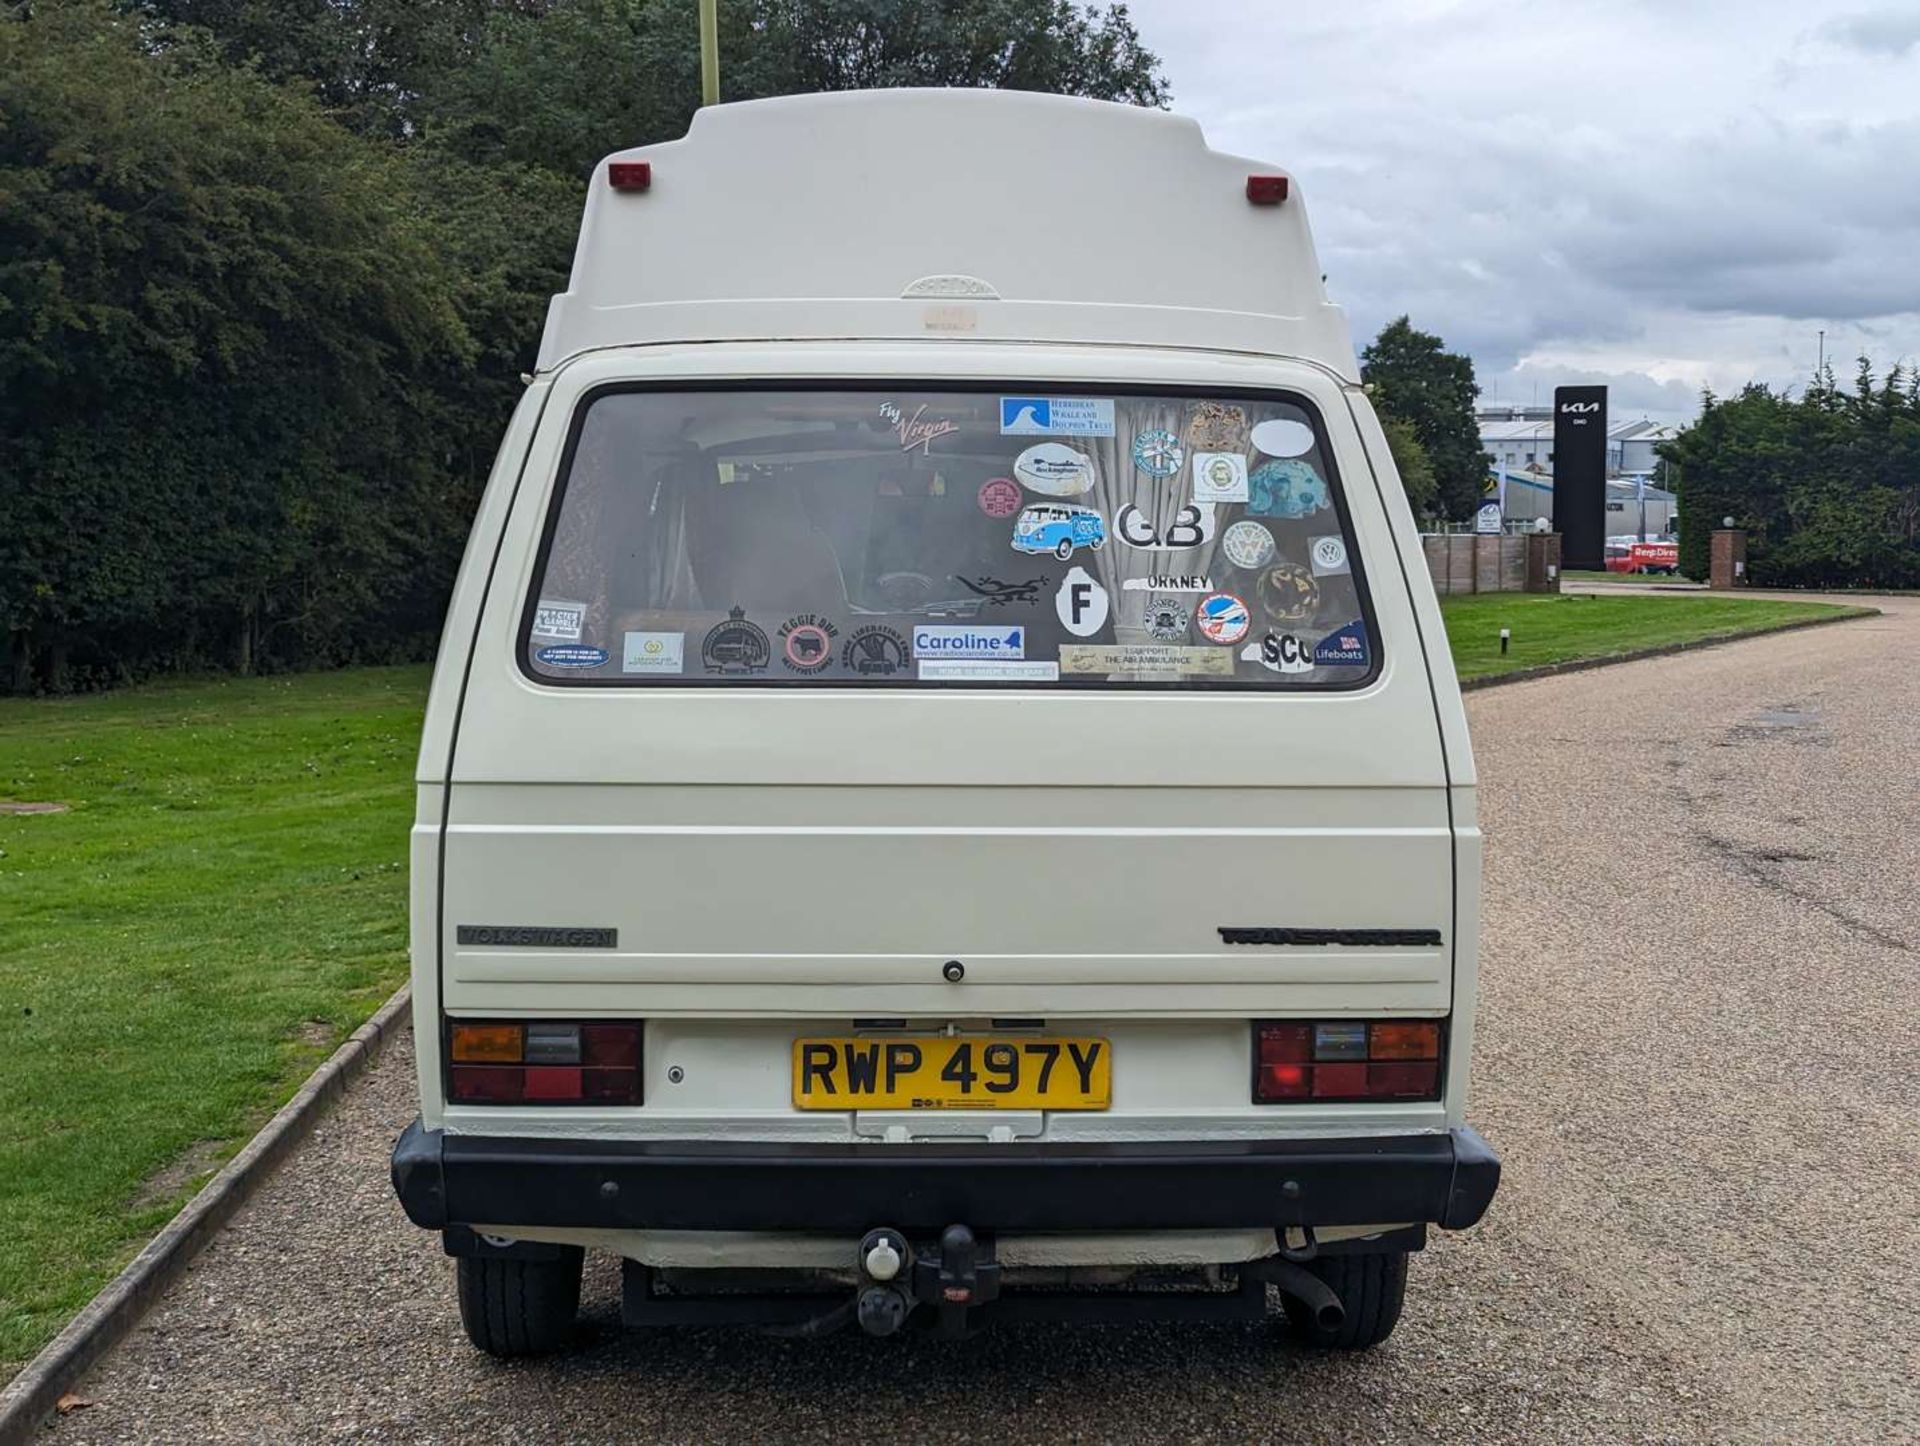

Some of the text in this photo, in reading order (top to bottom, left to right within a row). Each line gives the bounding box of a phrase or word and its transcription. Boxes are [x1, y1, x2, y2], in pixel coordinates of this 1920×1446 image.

[879, 401, 901, 424] Fly
[1562, 402, 1599, 413] KIA
[895, 403, 960, 456] Virgin
[1118, 503, 1205, 547] GB
[1147, 575, 1209, 589] ORKNEY
[1071, 583, 1092, 625] F
[916, 632, 1001, 650] Caroline
[916, 650, 1021, 659] www.radiocaroline.co.uk
[1105, 656, 1122, 665] THE
[1138, 656, 1191, 666] AMBULANCE
[1315, 649, 1364, 661] Lifeboats
[461, 928, 613, 946] VOLKSWAGEN
[802, 1043, 1101, 1095] RWP 497Y
